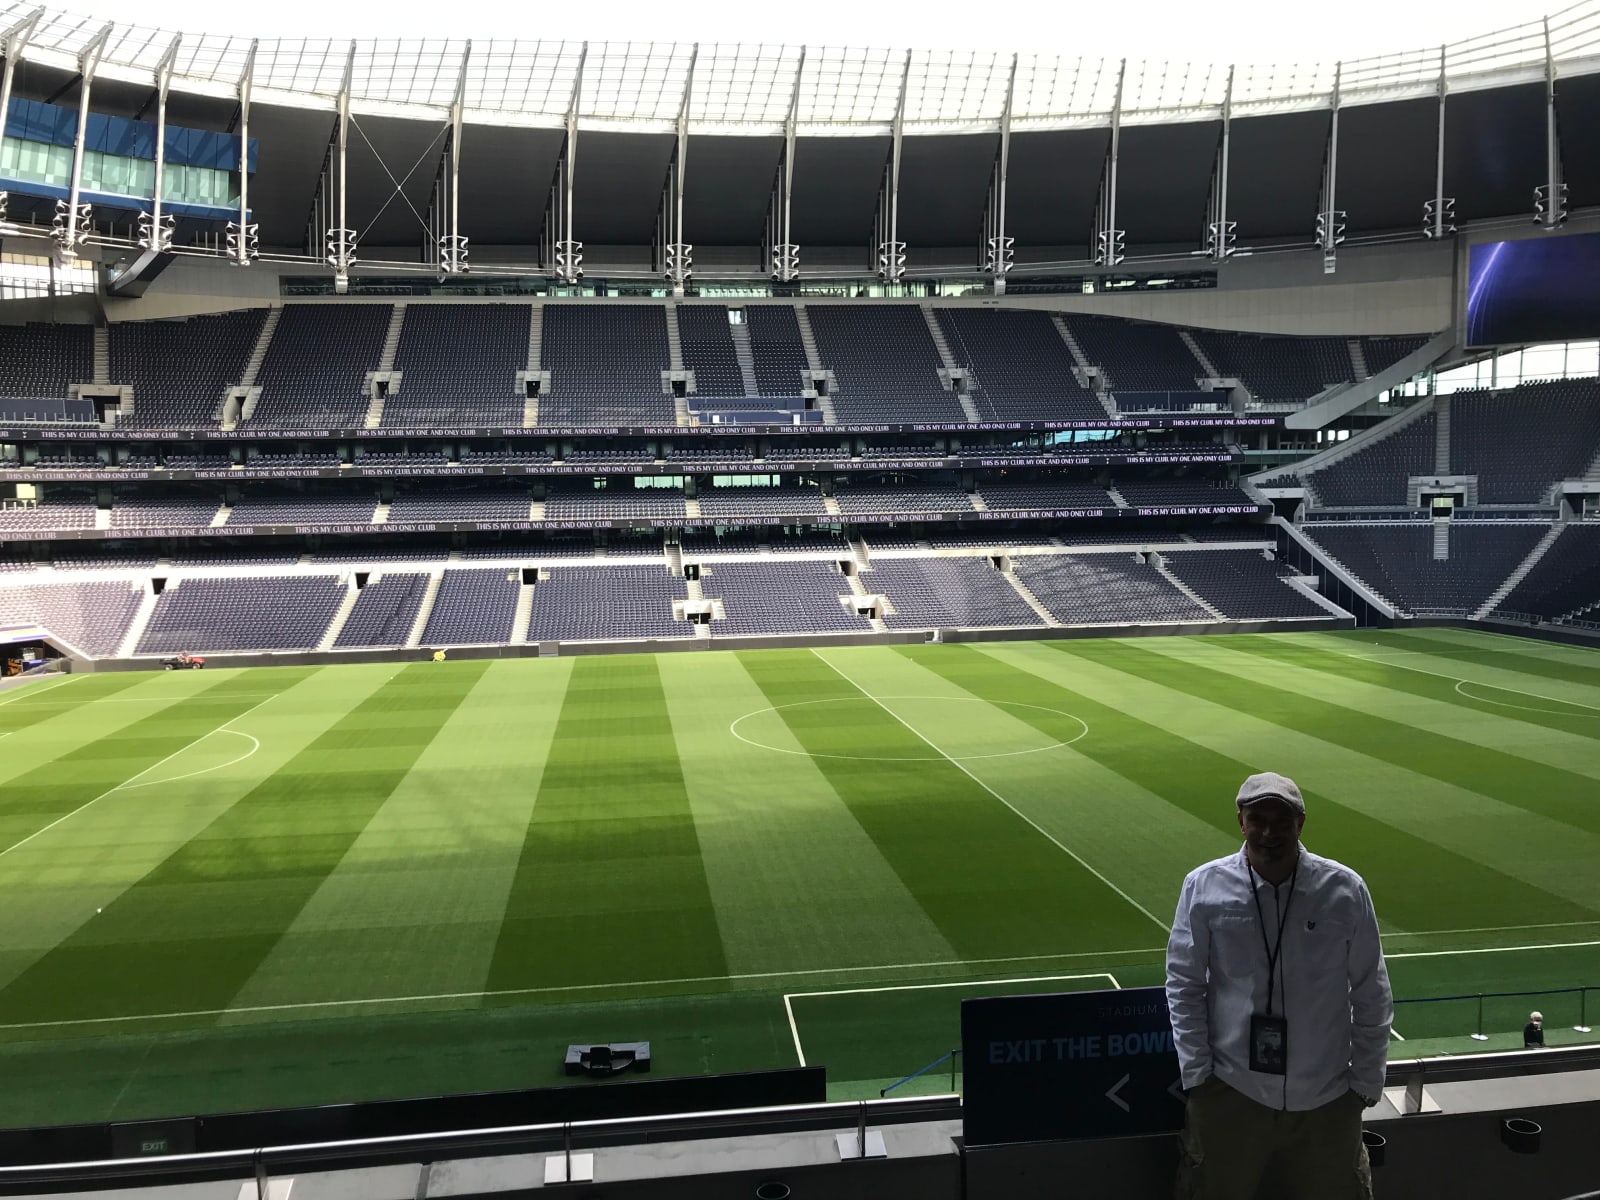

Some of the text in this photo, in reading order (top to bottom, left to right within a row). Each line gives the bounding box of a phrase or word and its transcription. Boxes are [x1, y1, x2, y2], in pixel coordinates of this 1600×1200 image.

[34, 531, 56, 540] CLUB
[295, 526, 311, 534] THIS
[1098, 1004, 1158, 1018] STADIUM
[989, 1039, 1046, 1064] EXIT
[1052, 1036, 1101, 1060] THE
[142, 1141, 166, 1152] EXIT
